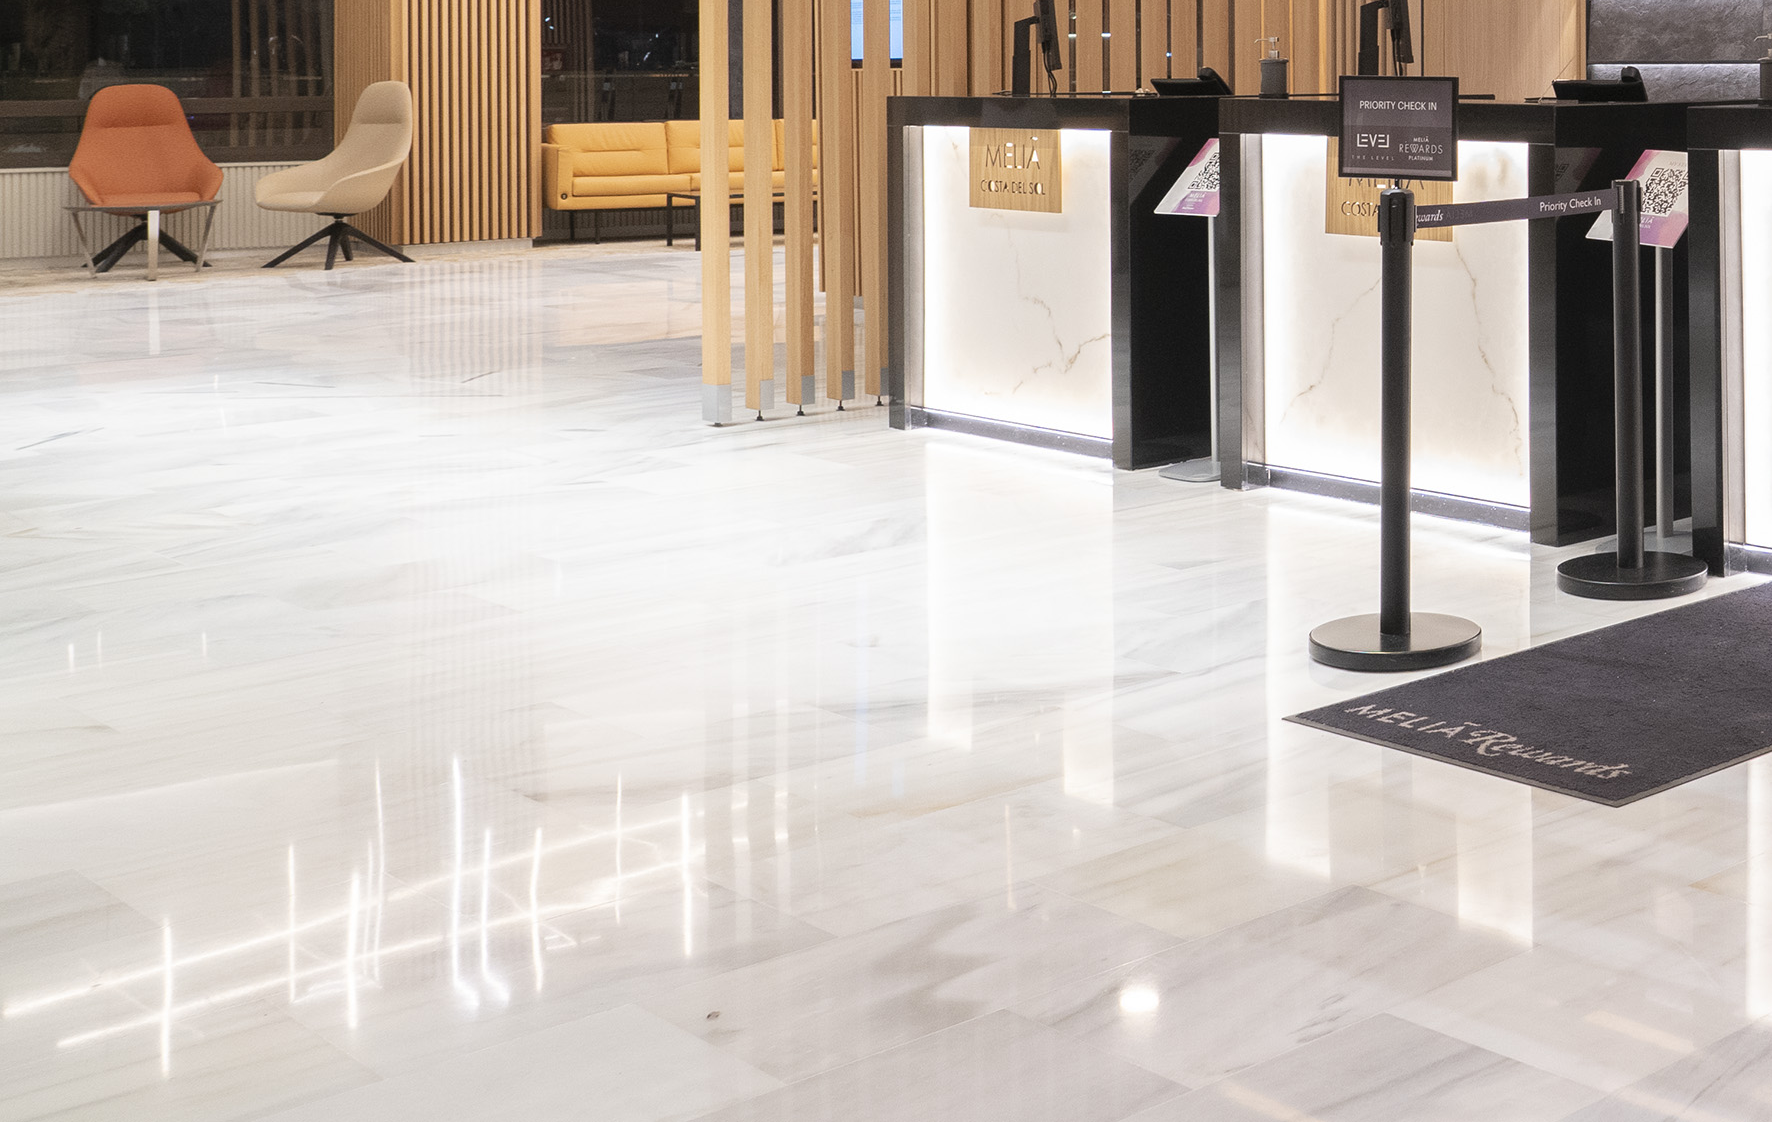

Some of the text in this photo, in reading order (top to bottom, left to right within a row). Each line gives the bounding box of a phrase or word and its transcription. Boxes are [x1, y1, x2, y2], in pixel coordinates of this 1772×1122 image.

[1359, 100, 1437, 111] PRIORITY CHECK IN
[980, 179, 1046, 195] COSTA DEL SOL
[1539, 196, 1602, 213] Priority Check In
[1461, 729, 1633, 780] Rewards
